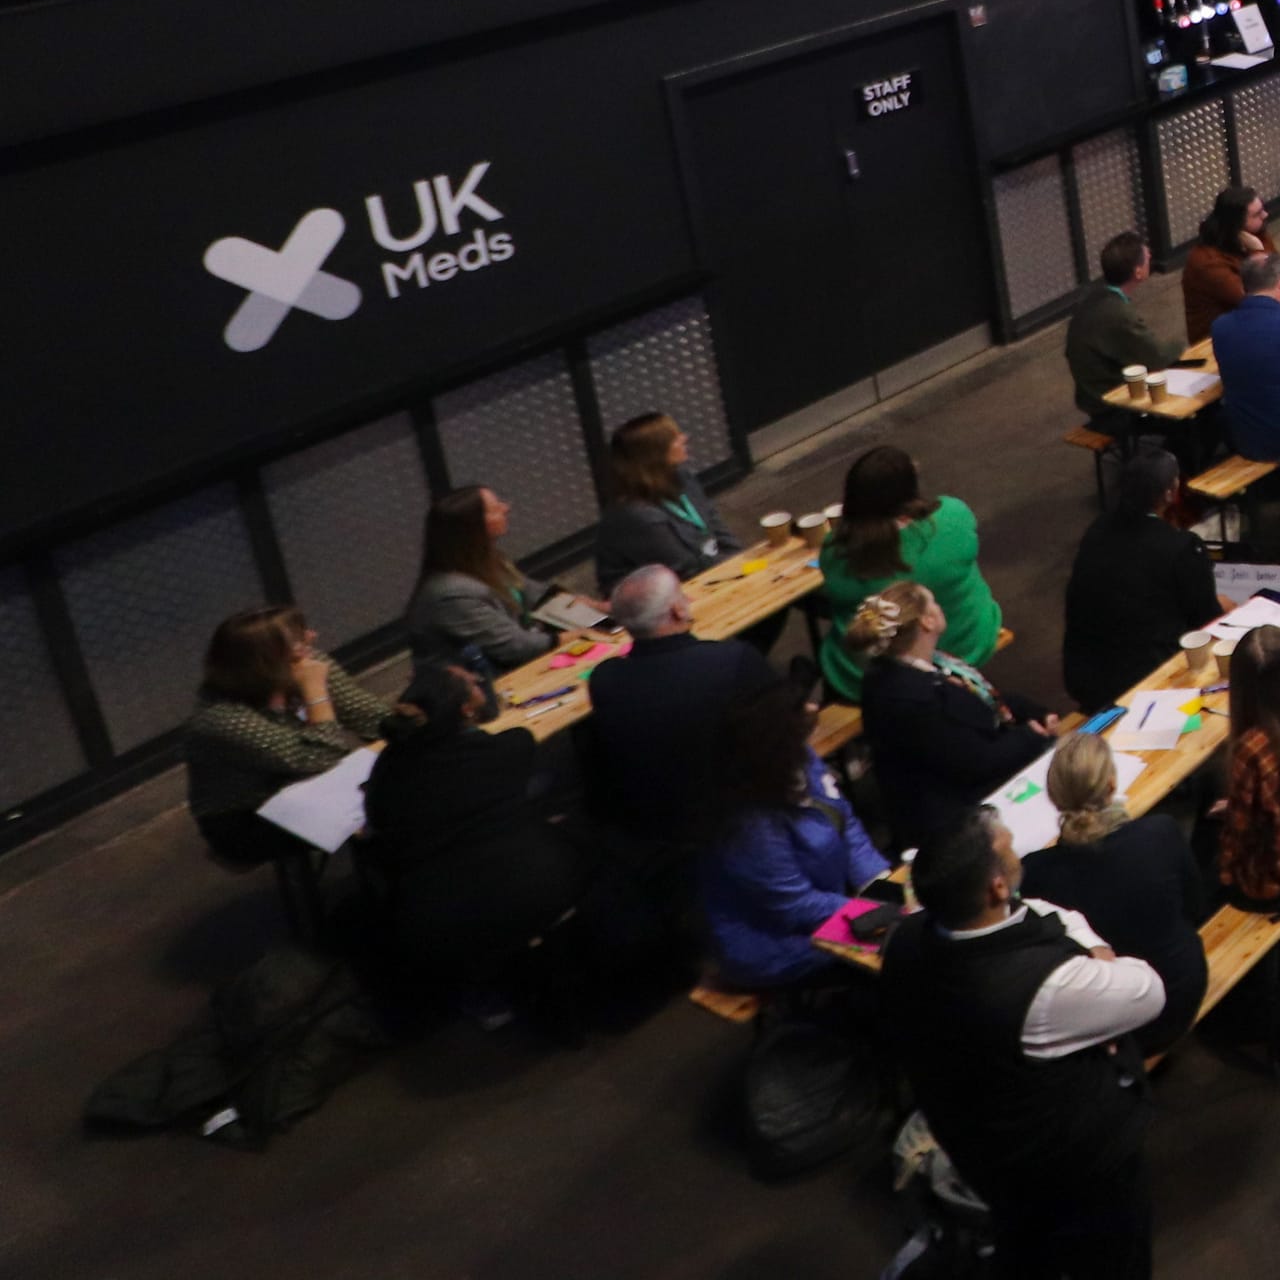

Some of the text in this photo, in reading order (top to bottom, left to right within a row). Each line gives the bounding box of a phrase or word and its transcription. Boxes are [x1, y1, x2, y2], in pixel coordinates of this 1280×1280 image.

[864, 74, 911, 100] STAFF
[868, 91, 910, 116] ONLY
[364, 161, 504, 252] UK
[381, 228, 515, 299] Meds
